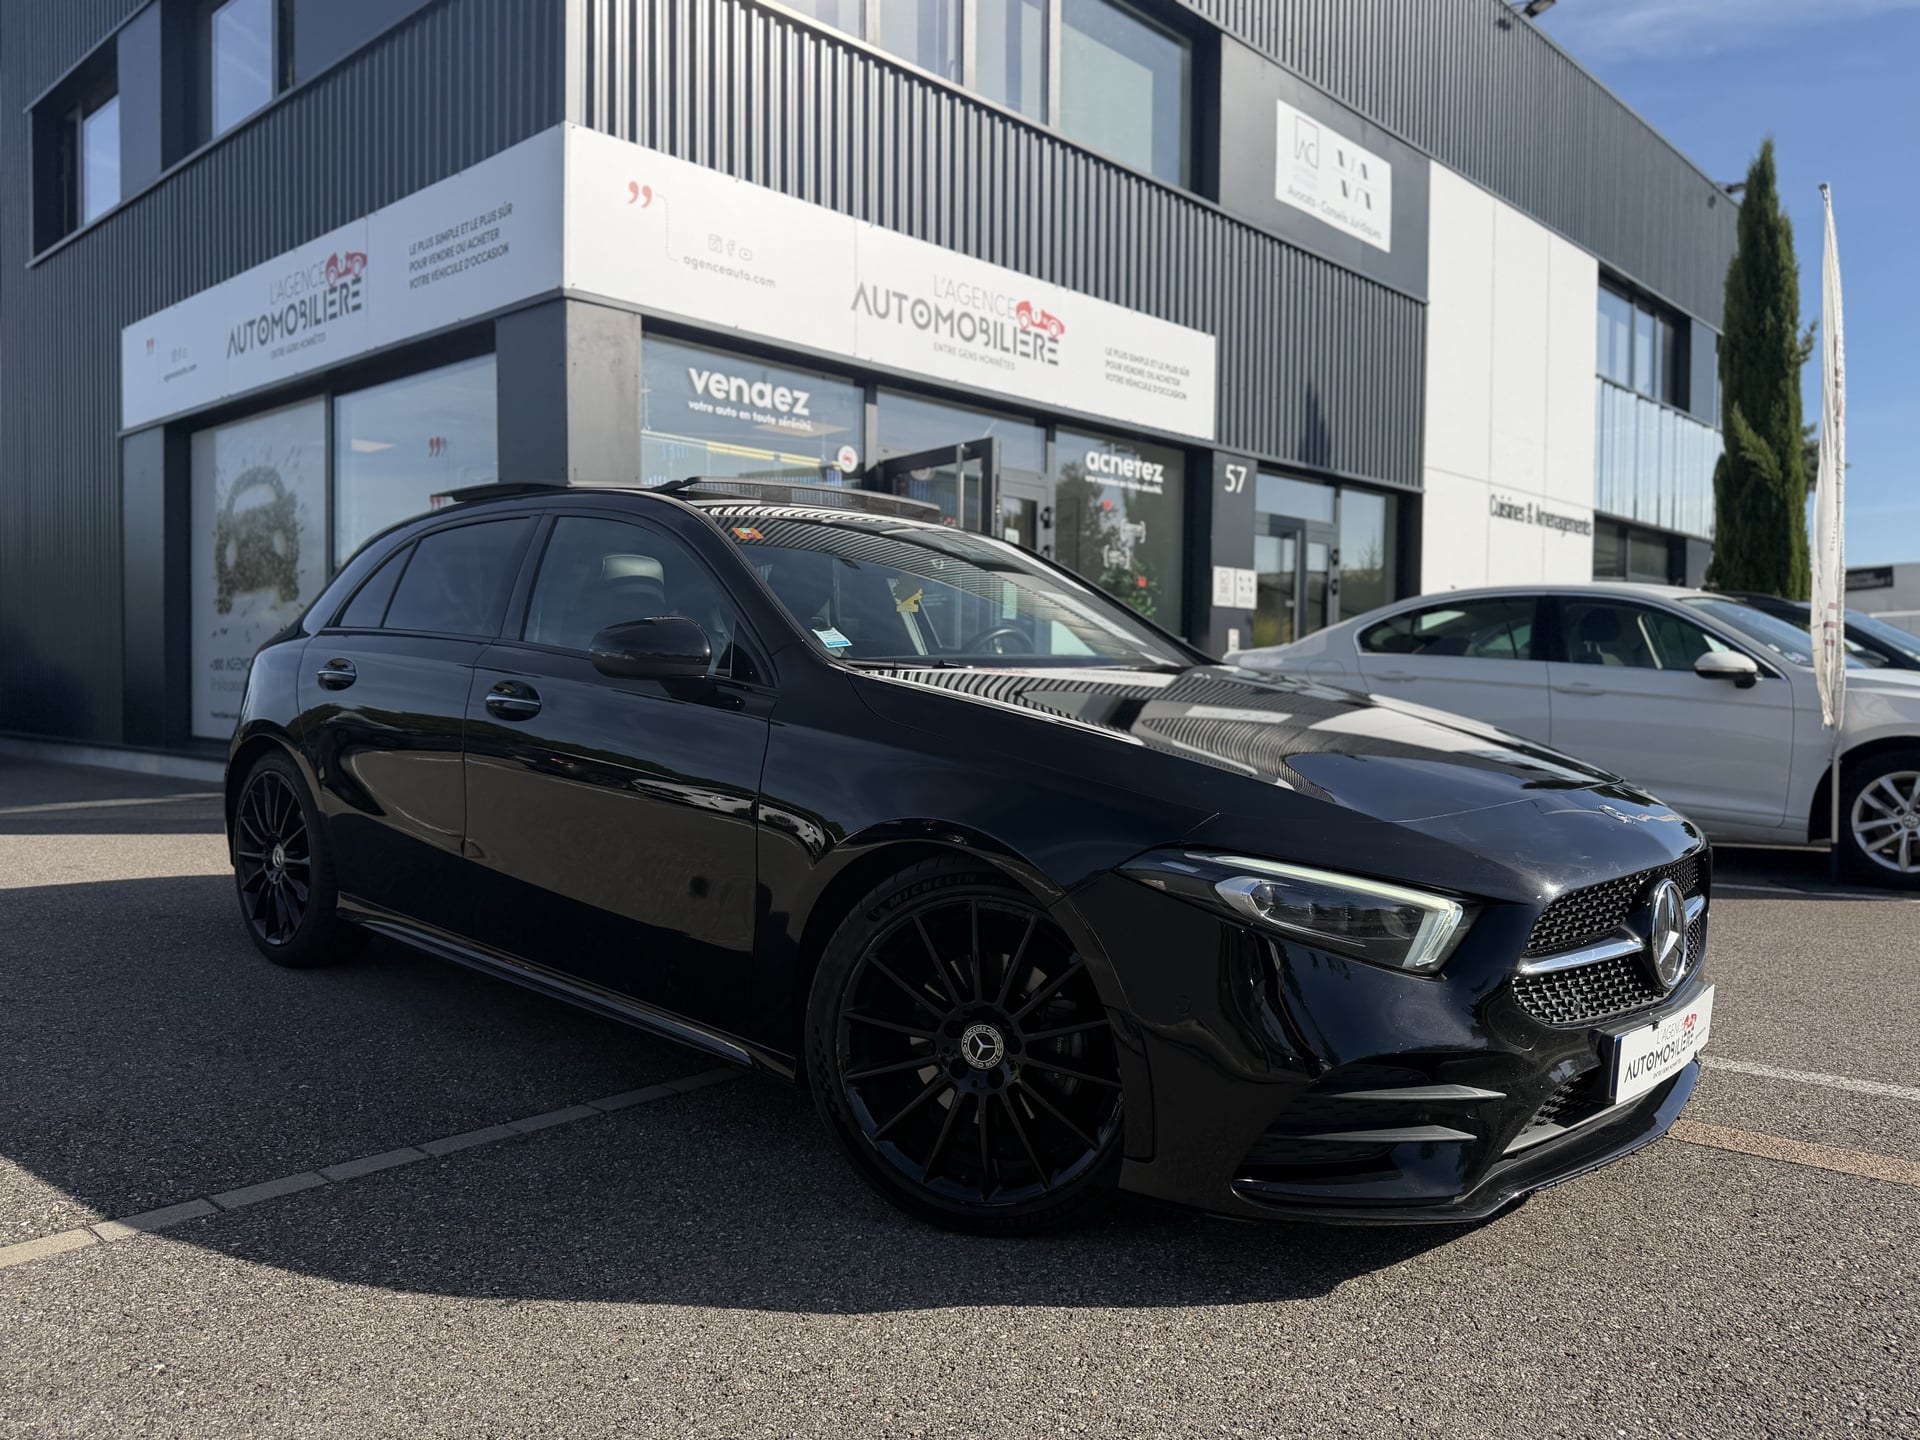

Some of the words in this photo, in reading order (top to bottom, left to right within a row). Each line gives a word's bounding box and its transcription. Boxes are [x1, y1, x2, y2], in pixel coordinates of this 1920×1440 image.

[269, 259, 326, 305] L'AGENCE
[683, 256, 776, 288] agenceauto.com
[933, 274, 1016, 320] L'AGENCE
[688, 366, 811, 417] vendez
[687, 401, 714, 414] votre
[715, 406, 738, 418] auto
[739, 411, 751, 420] en
[752, 412, 777, 425] toute
[1085, 443, 1164, 483] achetez
[1224, 463, 1248, 494] 57
[1489, 493, 1525, 523] Cuisines
